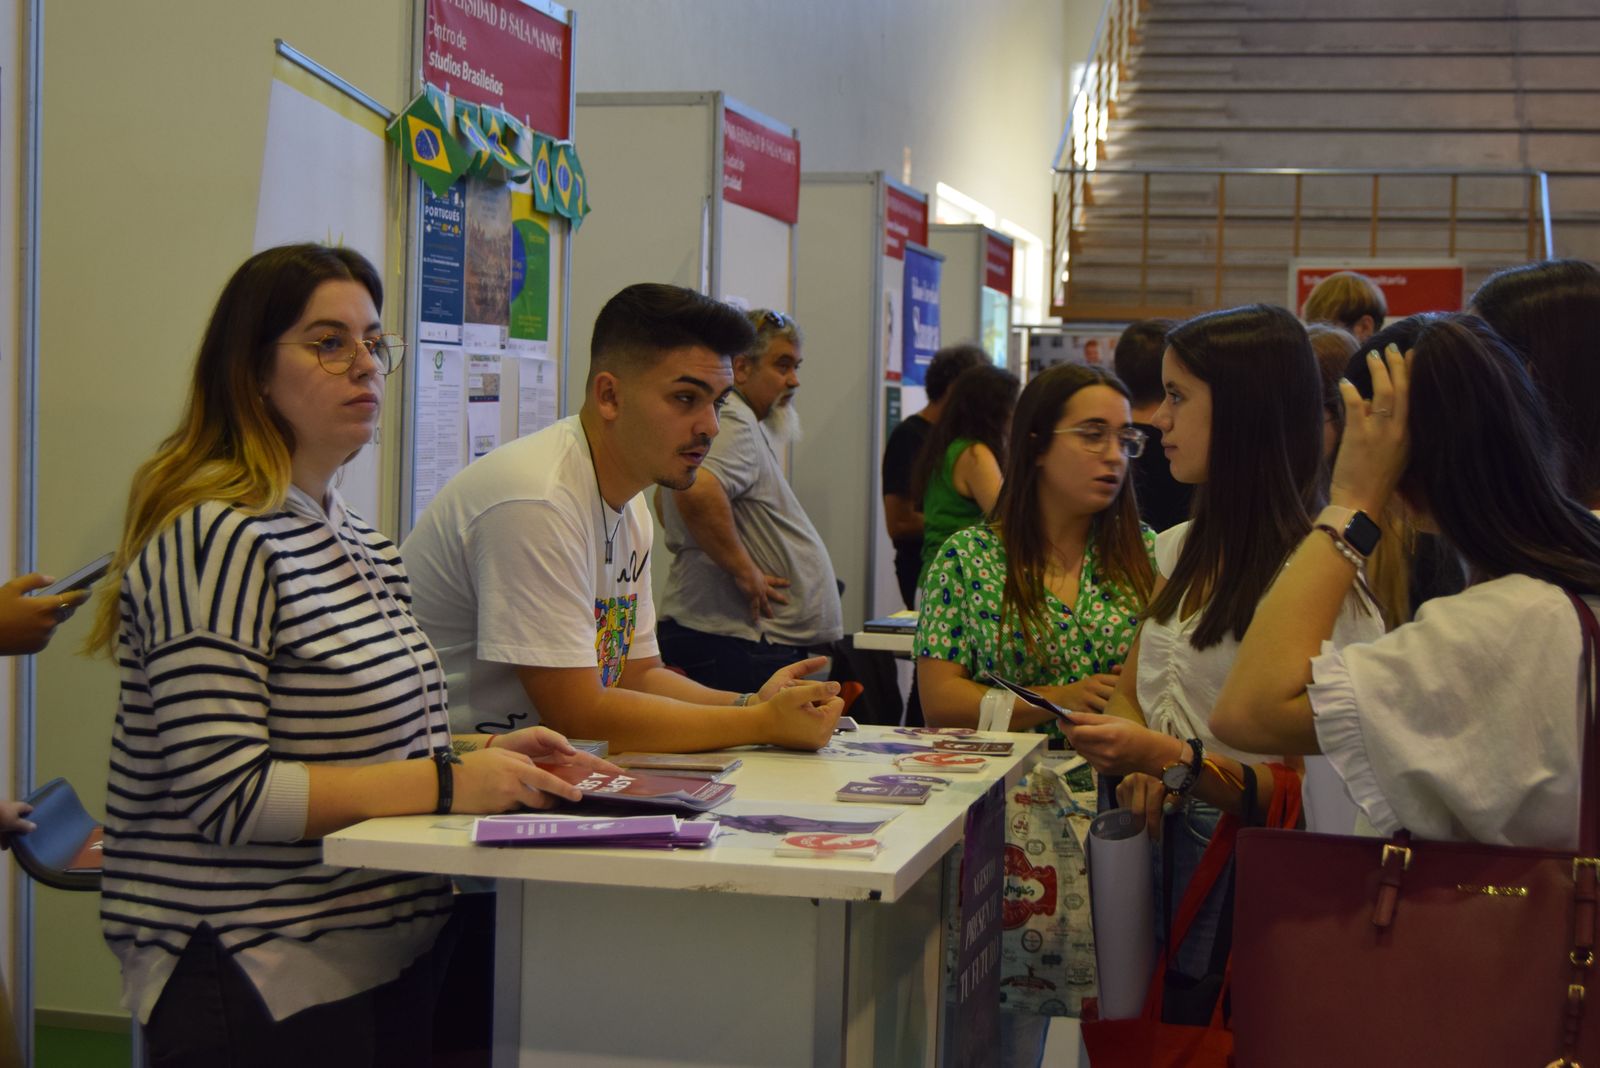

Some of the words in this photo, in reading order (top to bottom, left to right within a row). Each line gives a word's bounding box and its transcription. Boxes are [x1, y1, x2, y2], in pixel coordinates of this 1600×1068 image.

[456, 29, 467, 51] de
[428, 46, 461, 77] studios
[461, 60, 504, 96] Brasileños
